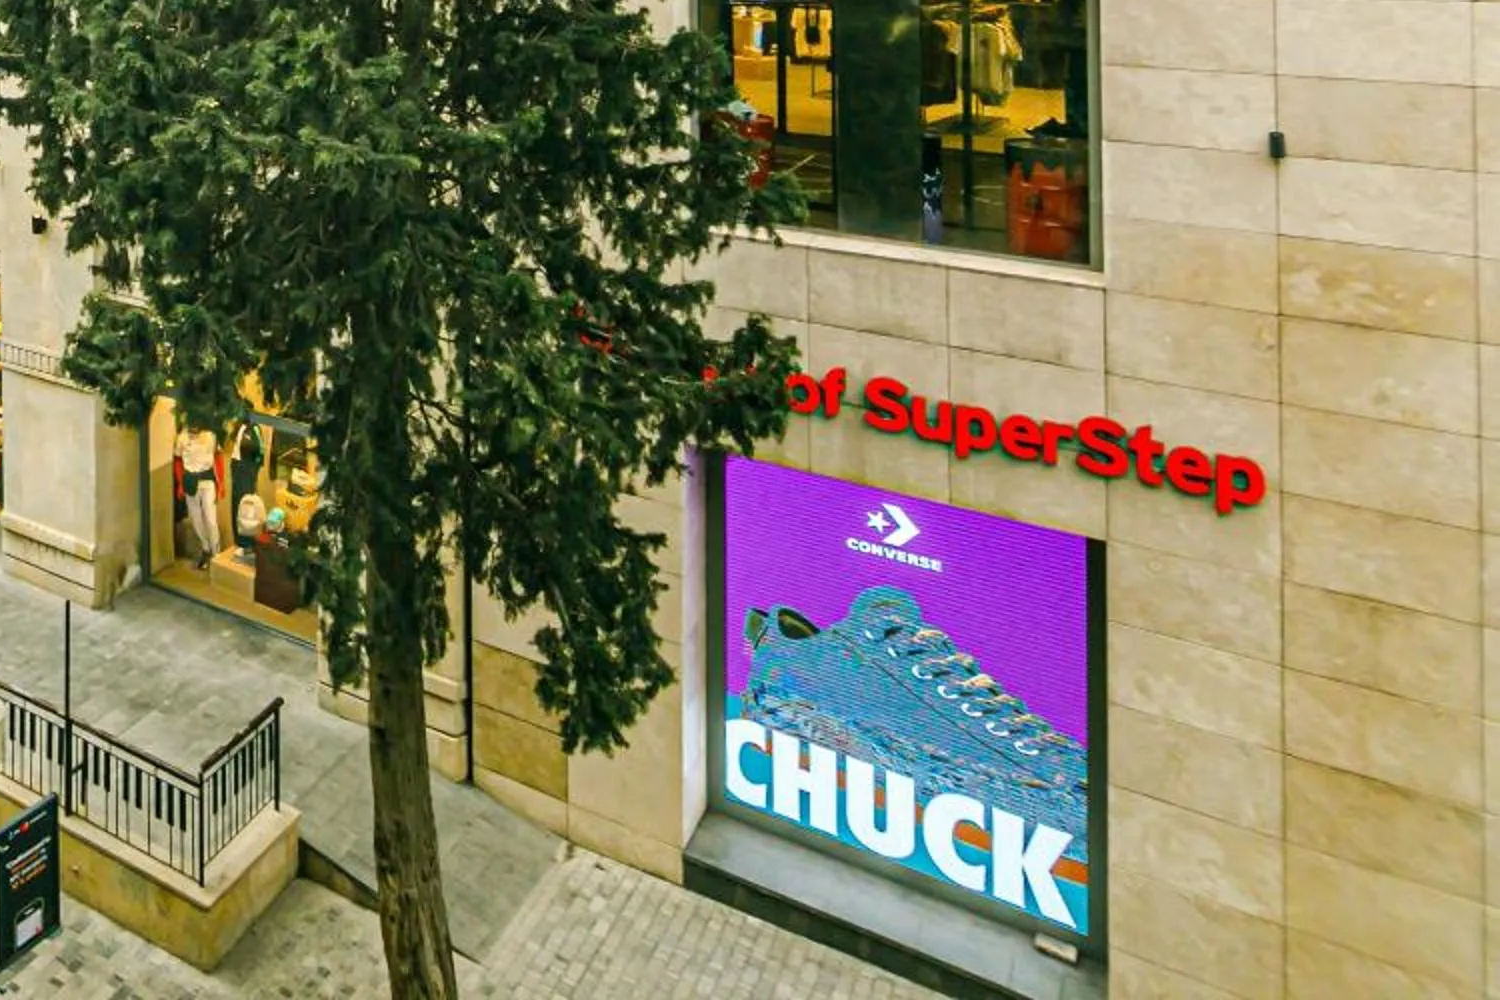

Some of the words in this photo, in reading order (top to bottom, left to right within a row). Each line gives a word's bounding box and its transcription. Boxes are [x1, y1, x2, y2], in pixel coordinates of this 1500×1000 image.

[784, 365, 848, 418] of
[862, 375, 1268, 515] SuperStep
[846, 537, 942, 573] CONVERSE
[725, 718, 1076, 929] CHUCK
